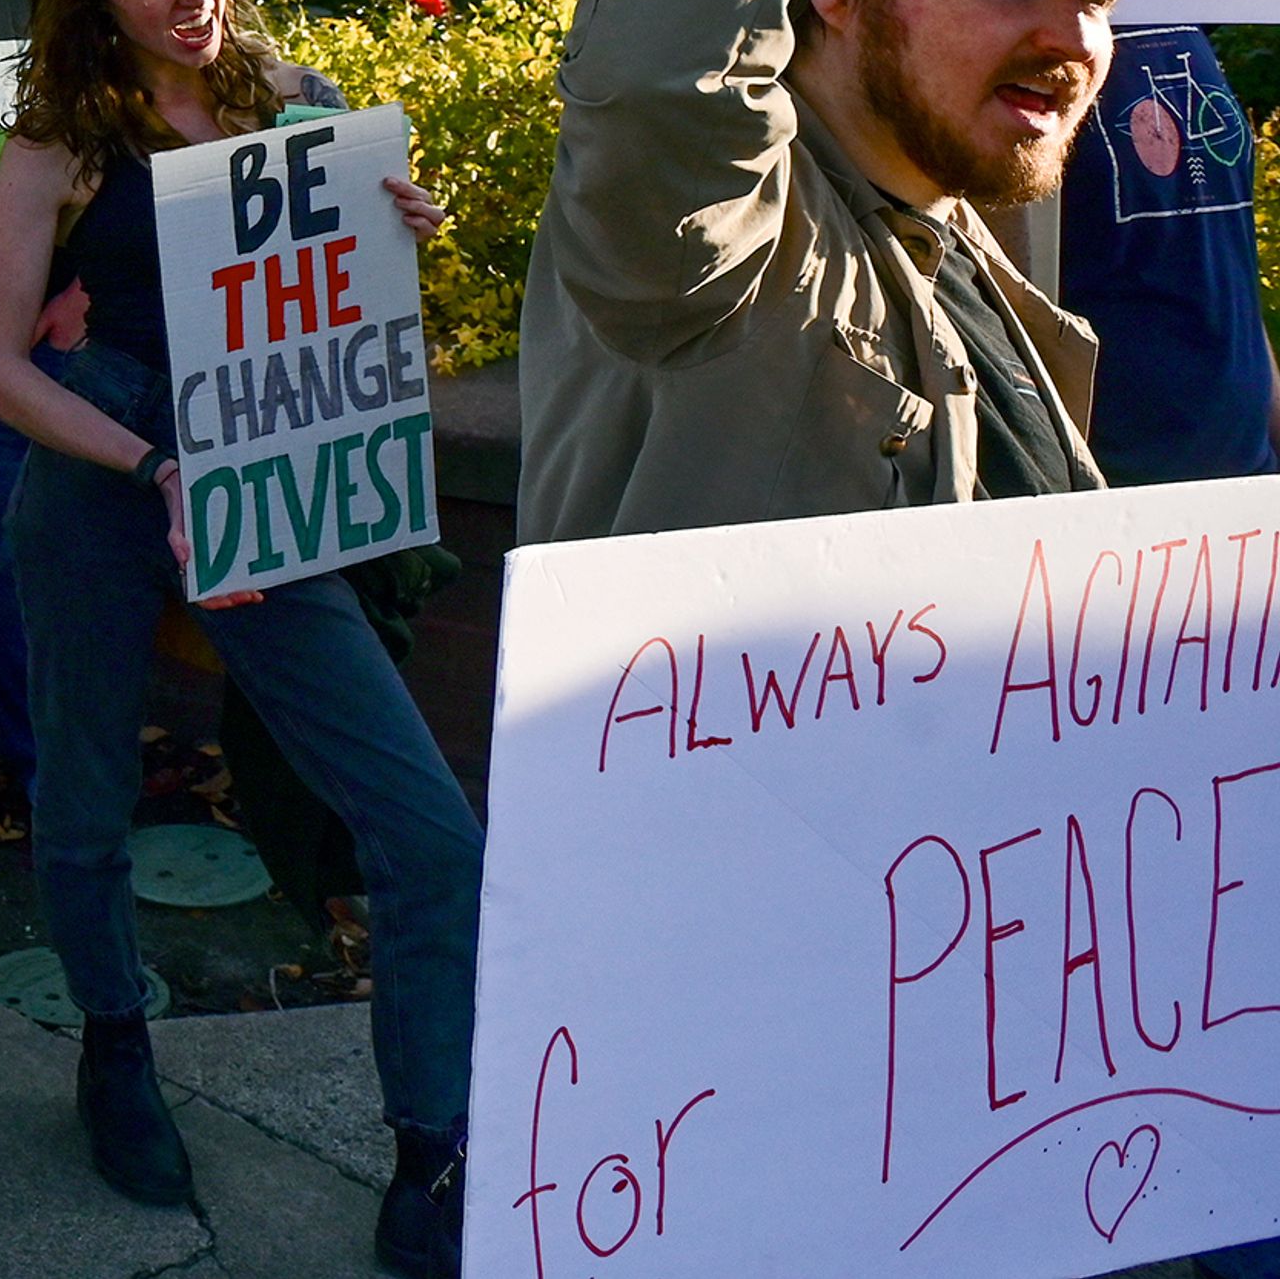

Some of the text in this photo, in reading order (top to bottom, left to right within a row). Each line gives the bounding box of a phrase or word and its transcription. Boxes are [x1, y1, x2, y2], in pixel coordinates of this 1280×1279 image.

[228, 126, 341, 256] BE
[177, 313, 425, 455] CHANGE
[211, 235, 362, 353] THE
[188, 412, 432, 596] DIVEST
[599, 527, 1280, 772] ALWAYS AGITATI
[883, 762, 1280, 1184] PEACE
[510, 1025, 716, 1279] for
